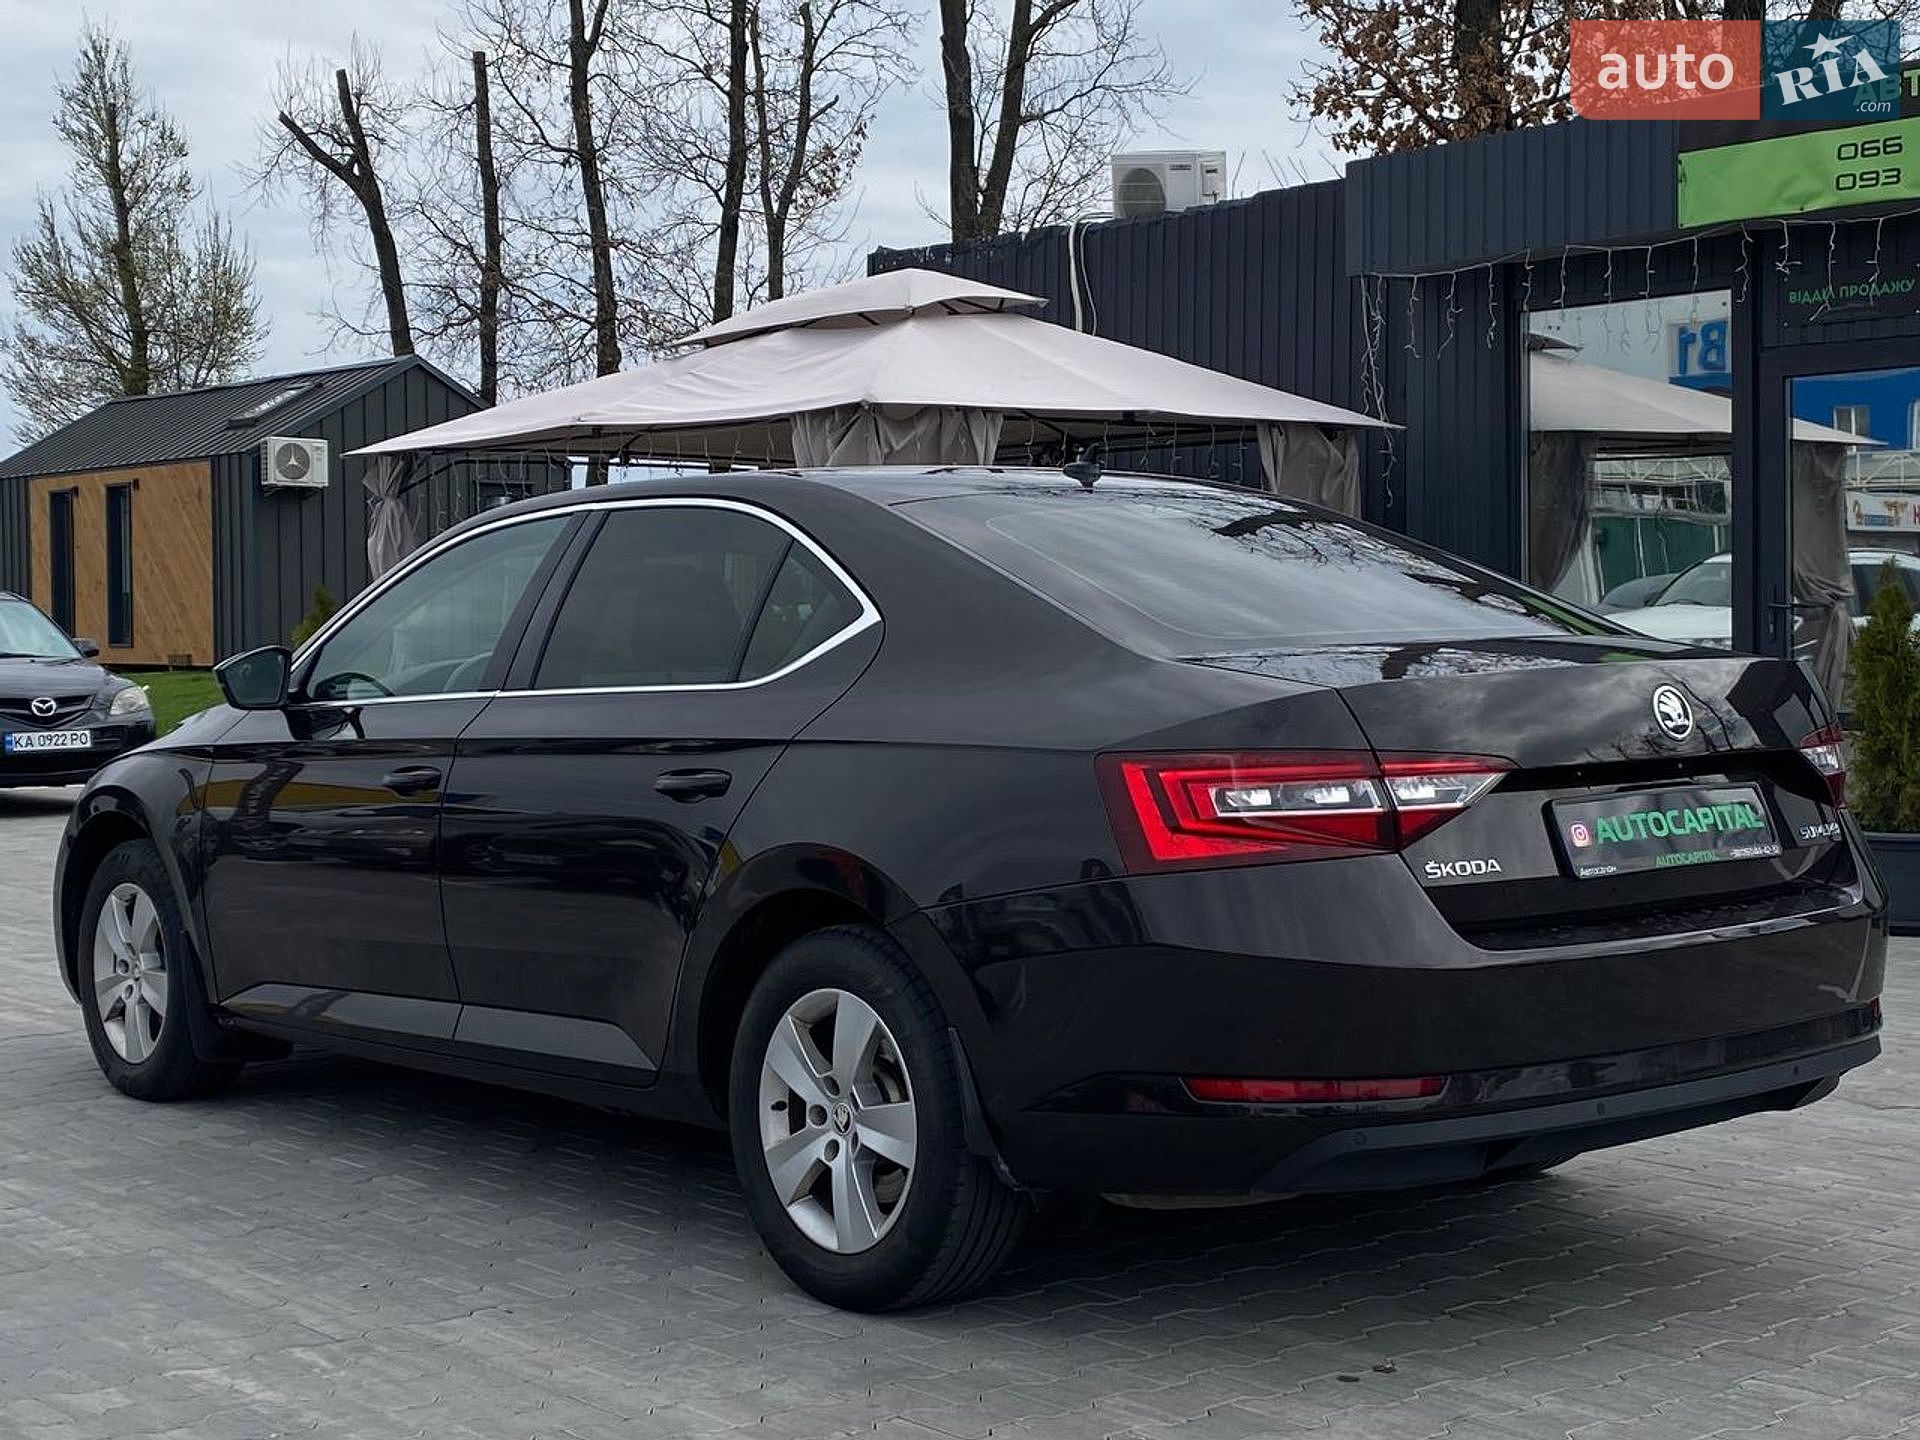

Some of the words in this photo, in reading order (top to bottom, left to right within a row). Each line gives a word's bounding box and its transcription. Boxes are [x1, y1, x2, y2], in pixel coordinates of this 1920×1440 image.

[1837, 135, 1903, 161] 066
[1836, 168, 1901, 191] 093
[1840, 279, 1916, 299] ПРОДАЖУ
[13, 735, 34, 748] KA
[37, 733, 68, 747] 0922
[70, 732, 88, 745] PO
[1596, 803, 1766, 844] AUTOCAPITAL
[1424, 859, 1502, 879] ŠKODA
